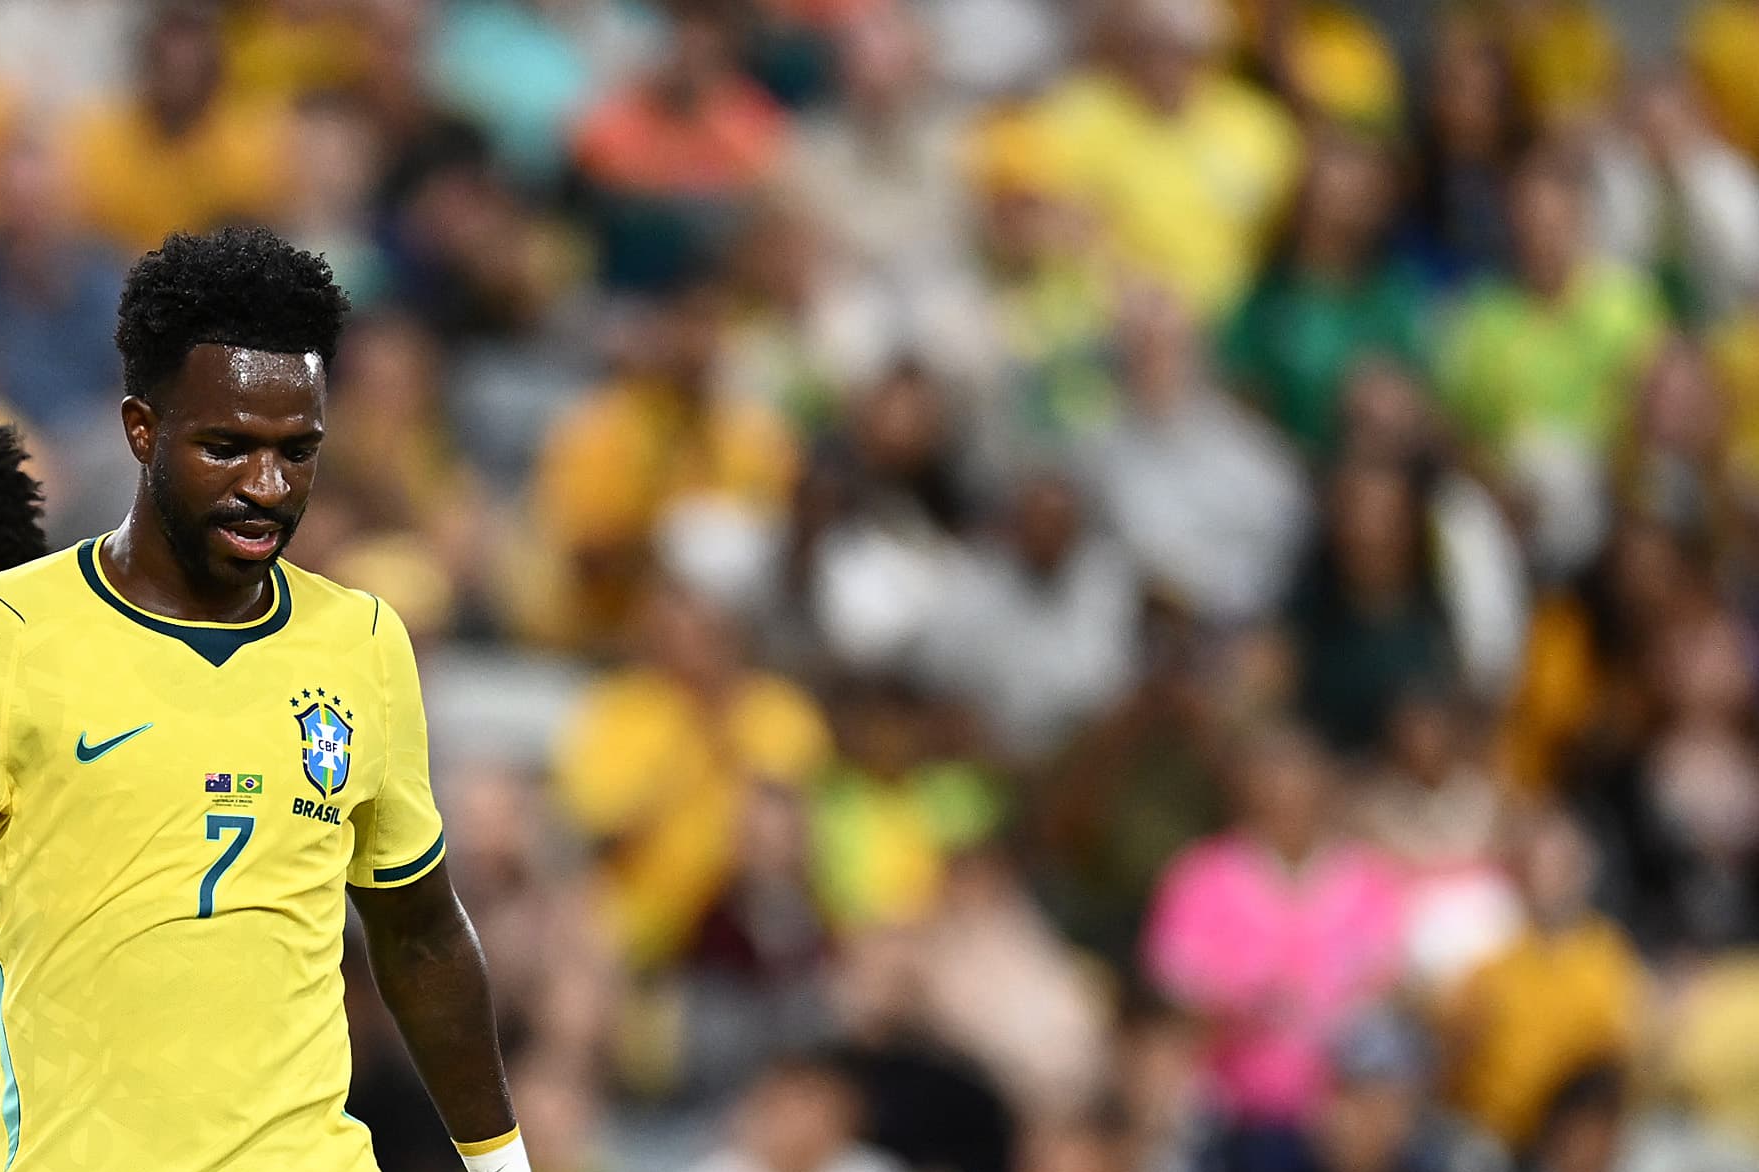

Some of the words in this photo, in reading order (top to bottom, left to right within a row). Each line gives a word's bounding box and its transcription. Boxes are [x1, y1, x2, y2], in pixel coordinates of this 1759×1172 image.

[318, 739, 338, 753] CBF
[292, 797, 341, 825] BRASIL
[197, 814, 255, 919] 7
